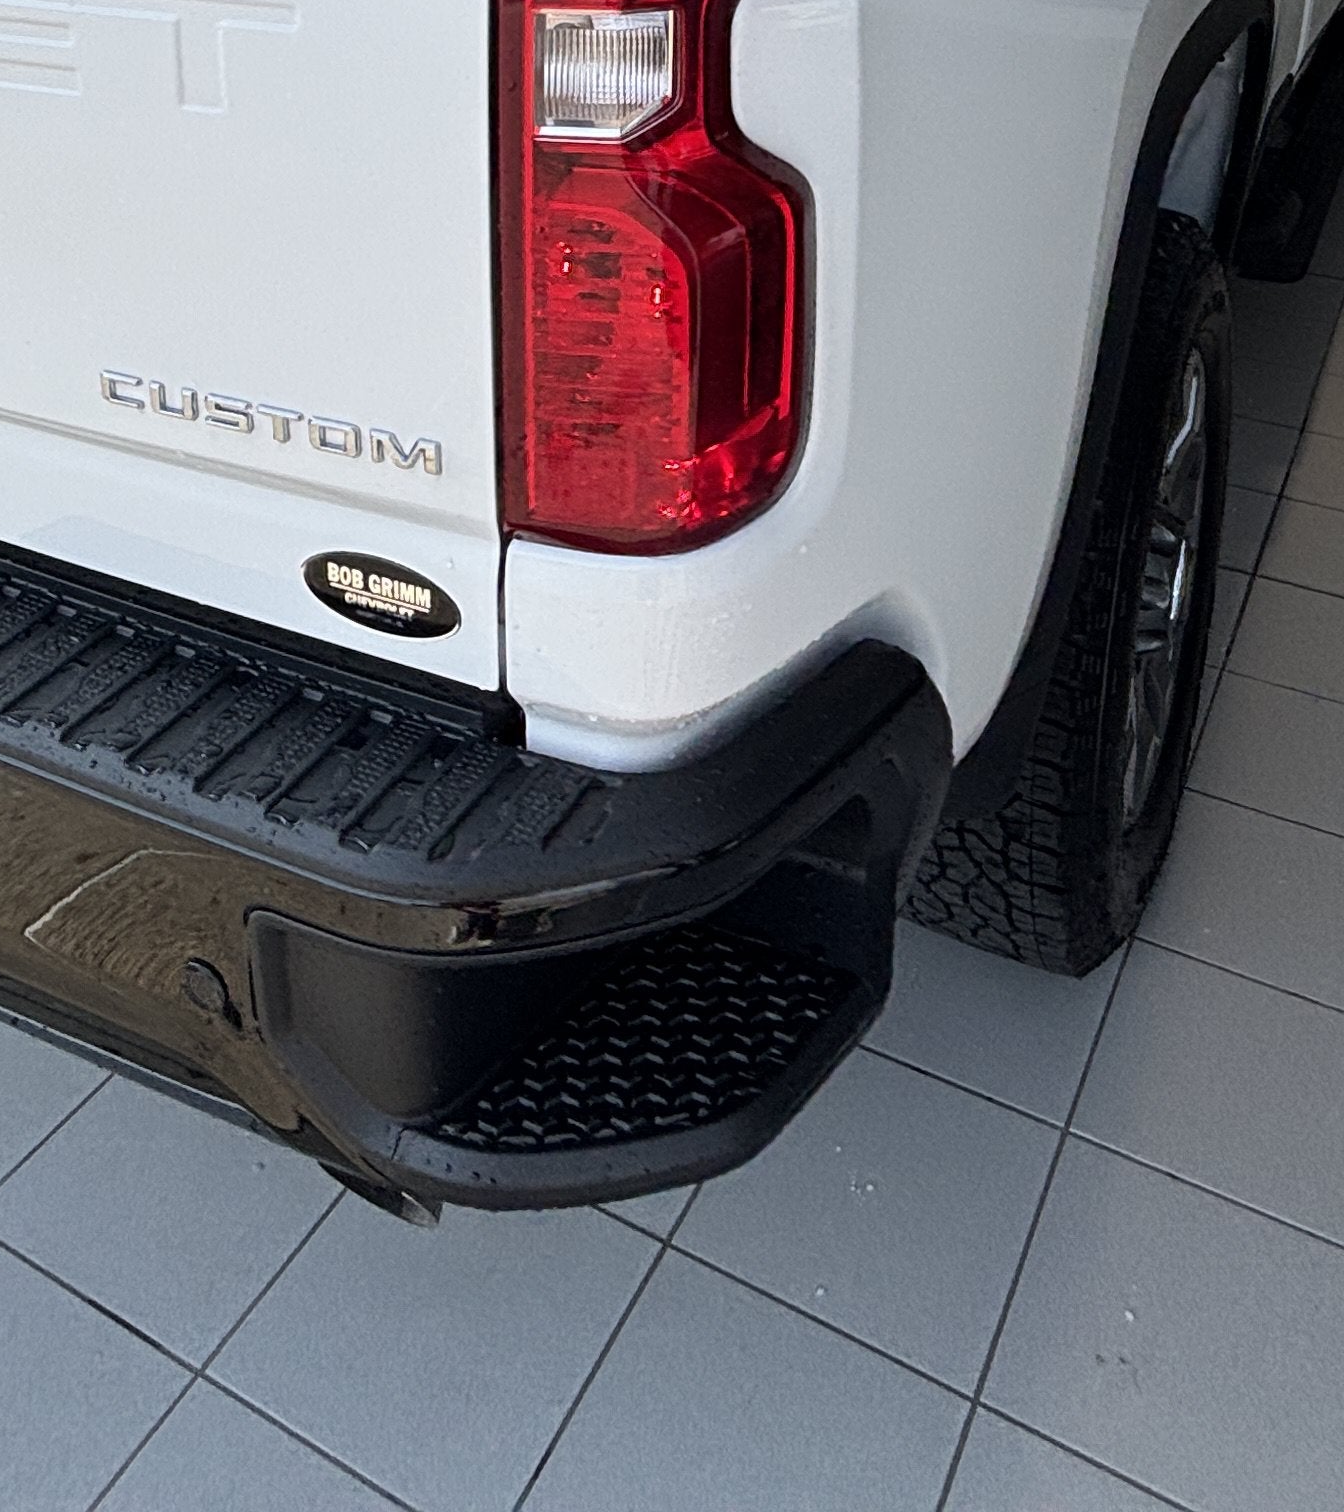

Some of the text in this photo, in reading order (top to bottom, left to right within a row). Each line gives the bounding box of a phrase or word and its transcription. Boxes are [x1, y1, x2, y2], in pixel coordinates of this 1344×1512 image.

[99, 369, 443, 476] CUSTOM
[326, 561, 432, 609] BOB GRIMM
